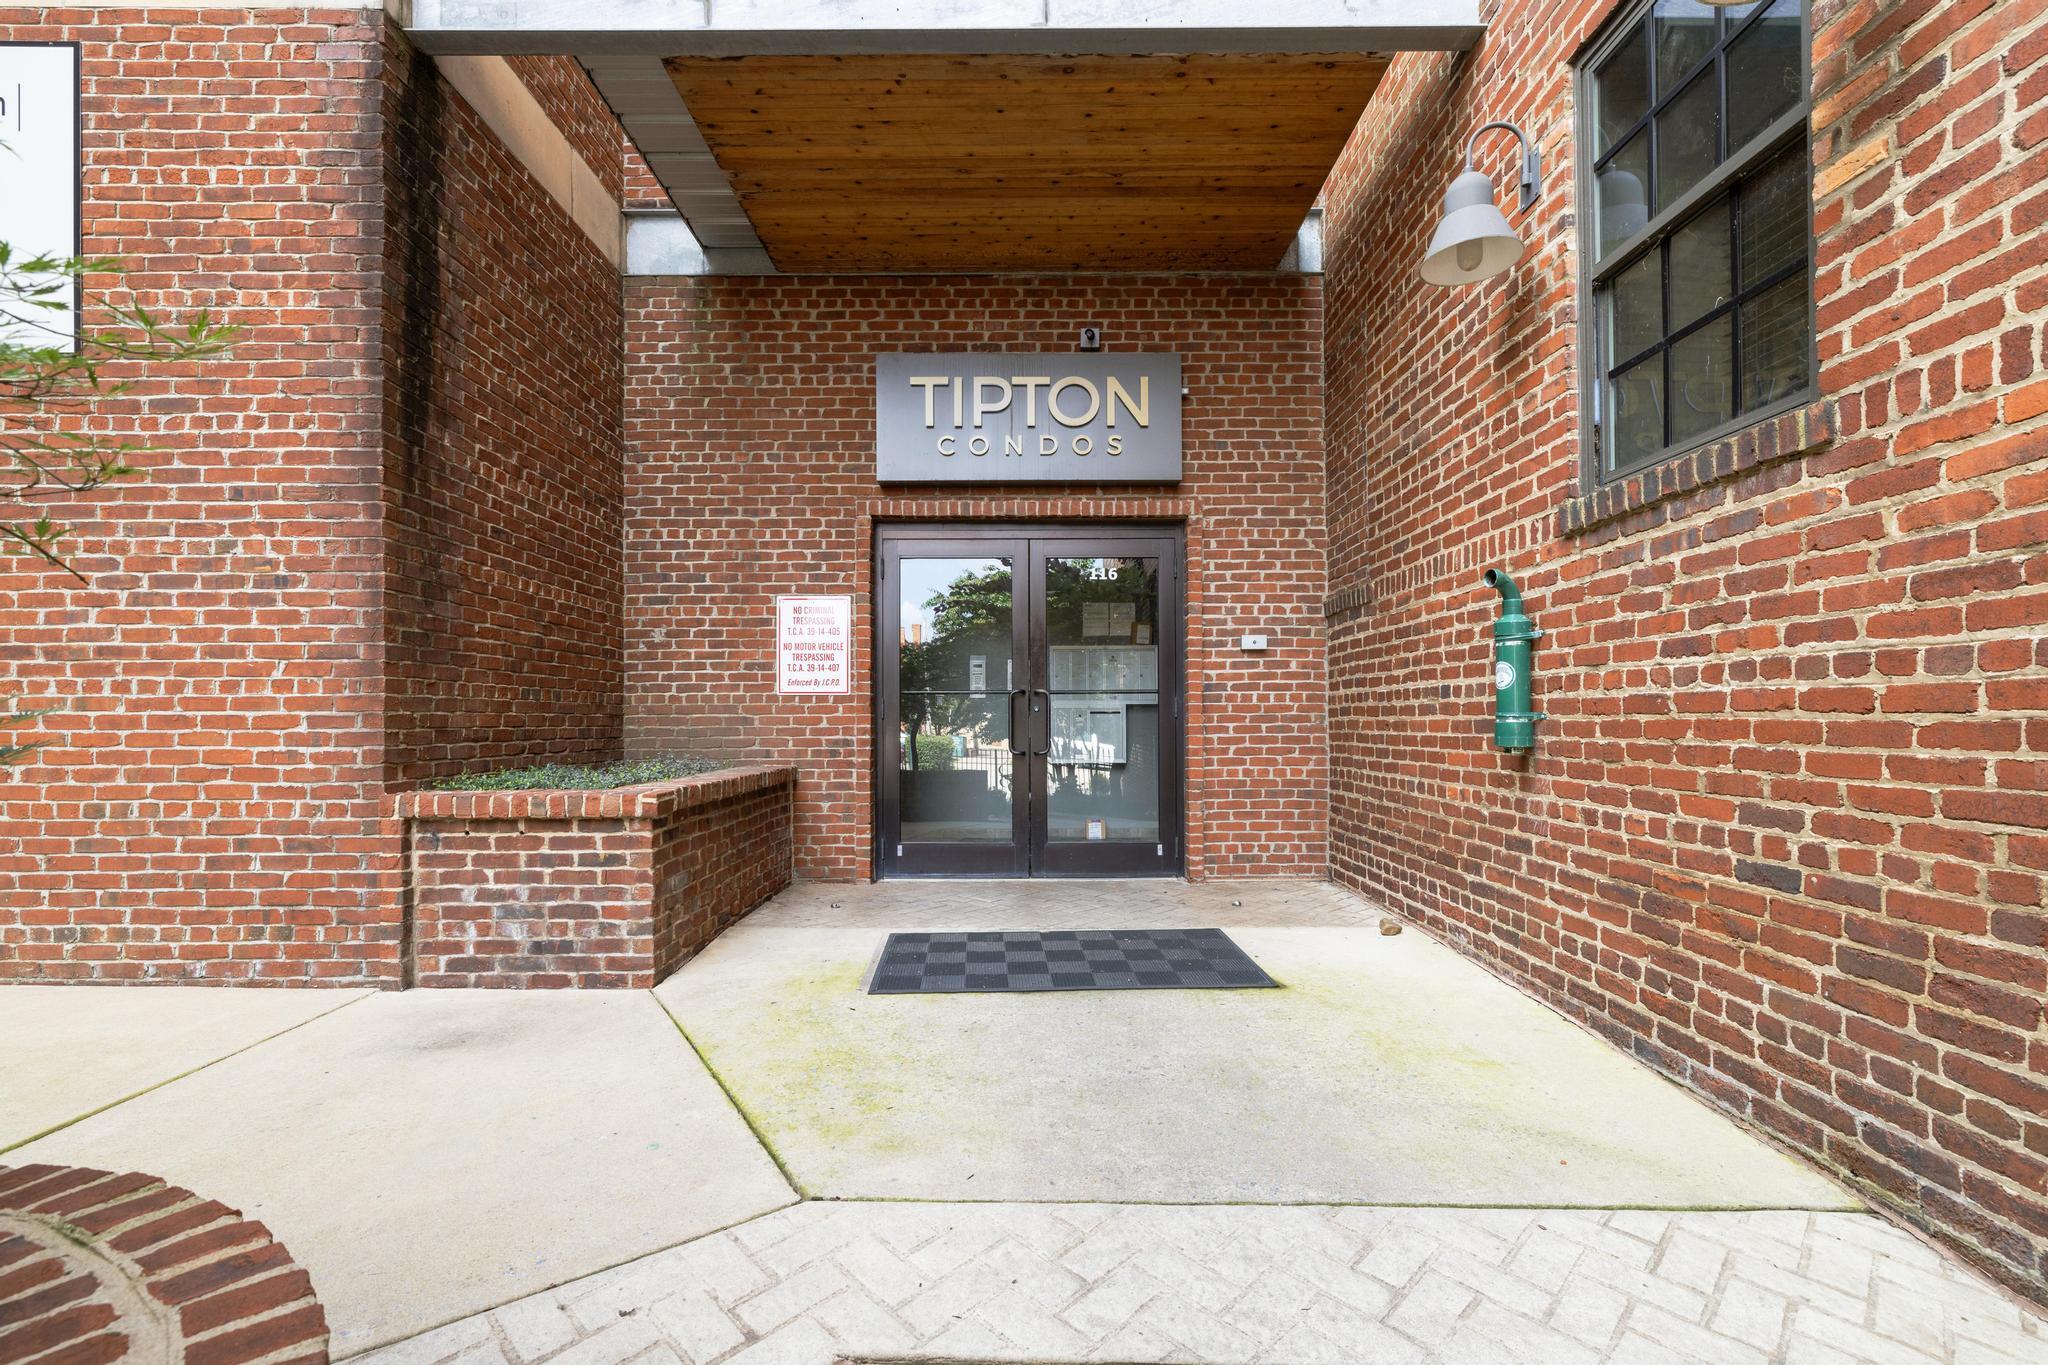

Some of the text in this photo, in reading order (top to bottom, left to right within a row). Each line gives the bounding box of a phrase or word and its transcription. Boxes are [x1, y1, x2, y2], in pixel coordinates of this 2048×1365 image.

[910, 376, 1149, 427] TIPTON
[937, 434, 1123, 456] CONDOS
[1090, 568, 1118, 580] 116
[793, 606, 835, 614] NO CRIMINAL
[793, 617, 835, 625] TRESPASSING
[783, 643, 844, 651] NO MOTOR VEHICLE
[792, 653, 835, 661] TRESPASSING
[787, 664, 839, 672] T.C.A. 39-14-407
[813, 679, 821, 687] By
